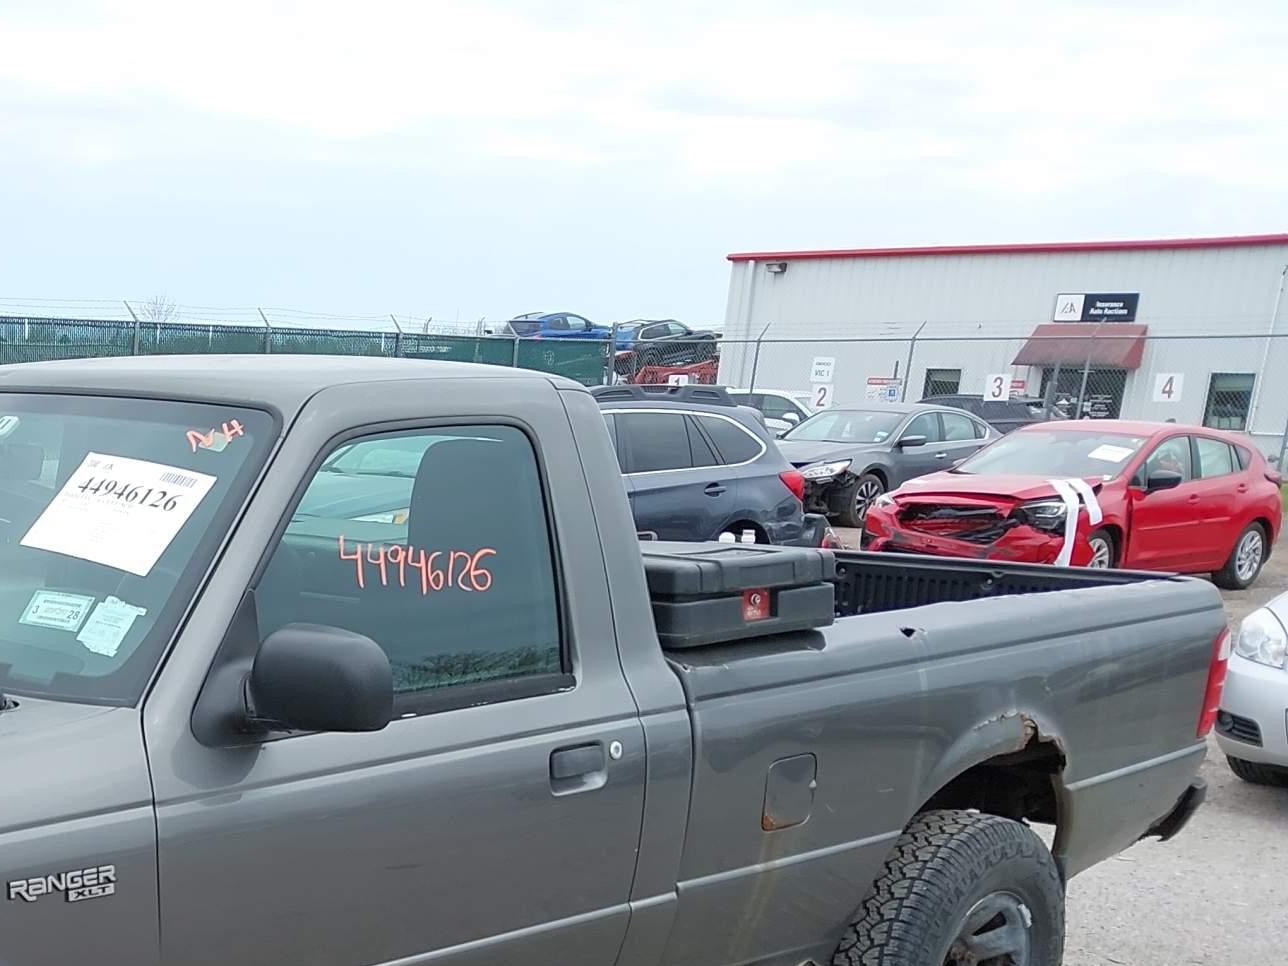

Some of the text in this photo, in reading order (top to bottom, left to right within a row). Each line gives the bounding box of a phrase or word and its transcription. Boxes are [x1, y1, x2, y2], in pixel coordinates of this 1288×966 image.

[815, 386, 828, 407] 2
[991, 376, 1004, 398] 3
[1161, 376, 1175, 399] 4
[78, 477, 183, 511] 44946126
[338, 534, 497, 595] 44946126
[7, 864, 117, 902] RANGER
[74, 885, 109, 899] XLT
